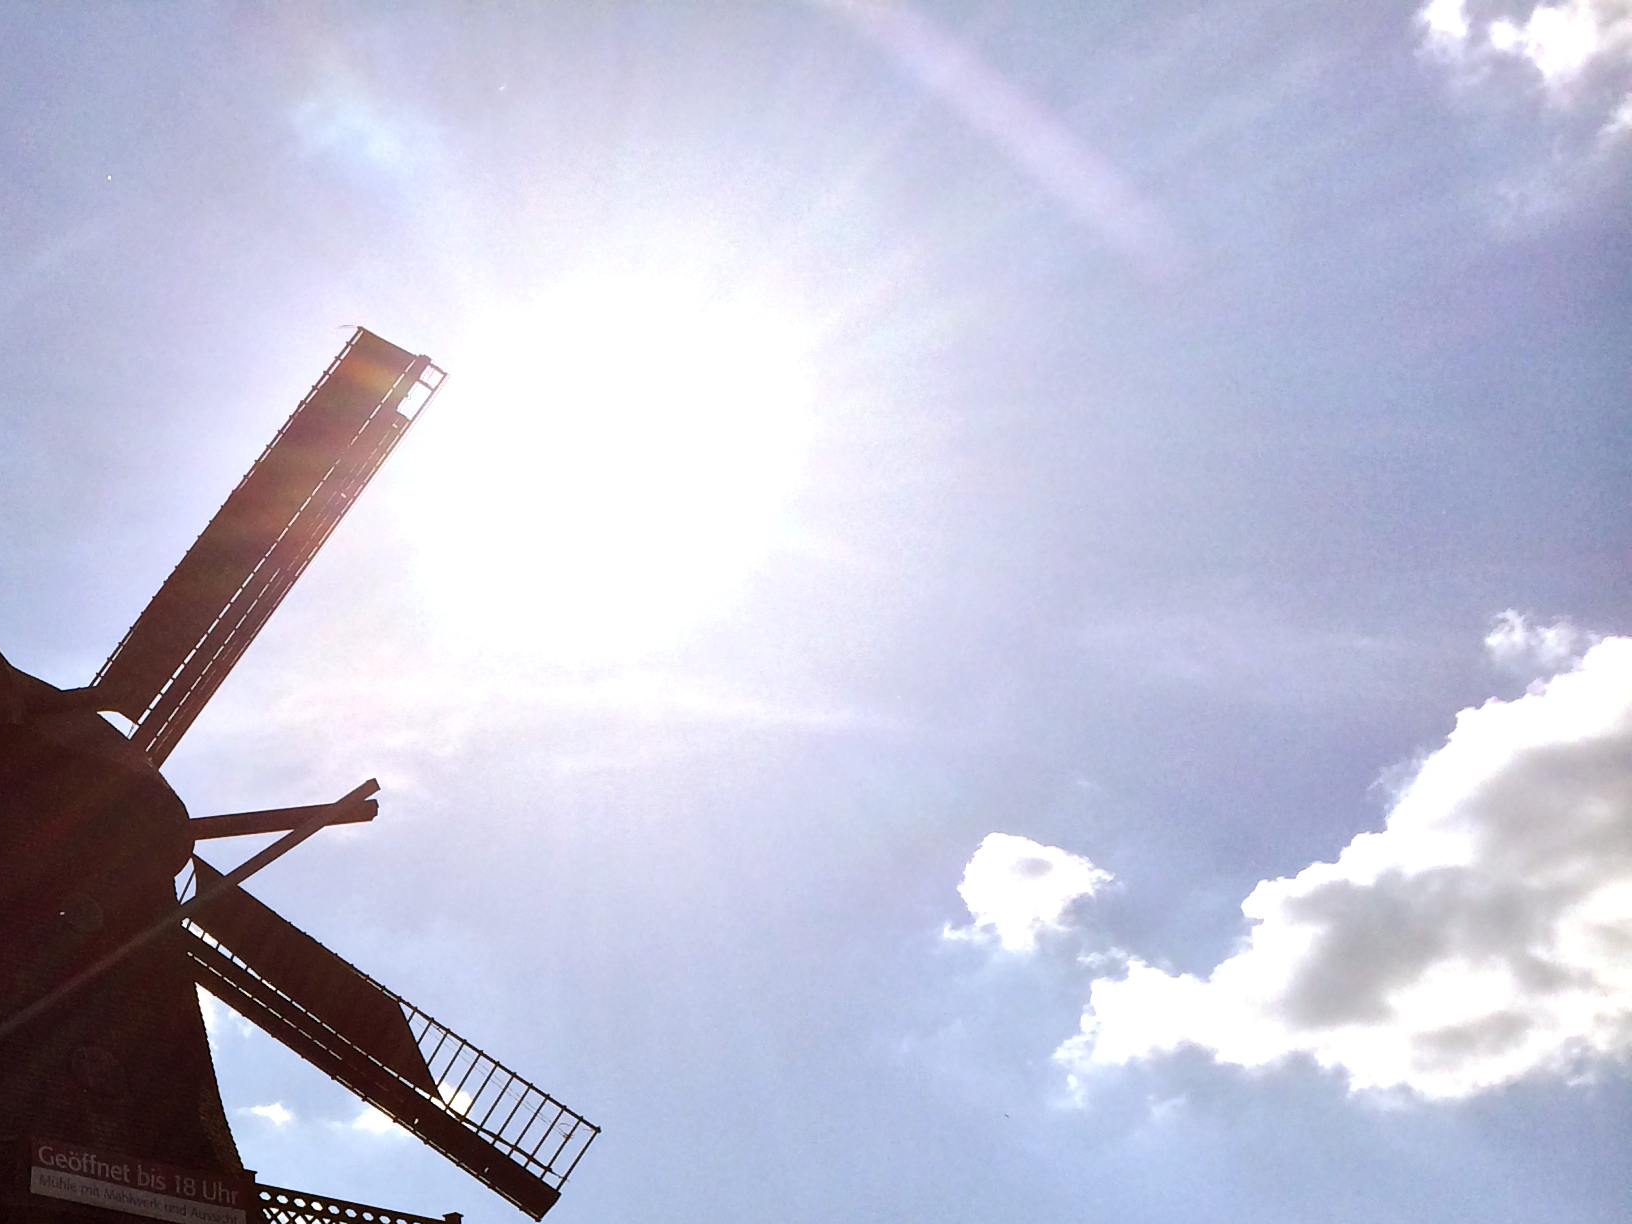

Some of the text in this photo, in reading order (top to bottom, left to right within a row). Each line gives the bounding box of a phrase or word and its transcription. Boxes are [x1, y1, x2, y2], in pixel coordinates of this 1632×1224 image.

[38, 1145, 239, 1205] Geöffnet bis 18 Uhr
[81, 1183, 100, 1199] mit
[103, 1188, 161, 1210] Mahlwerk
[164, 1201, 187, 1217] und
